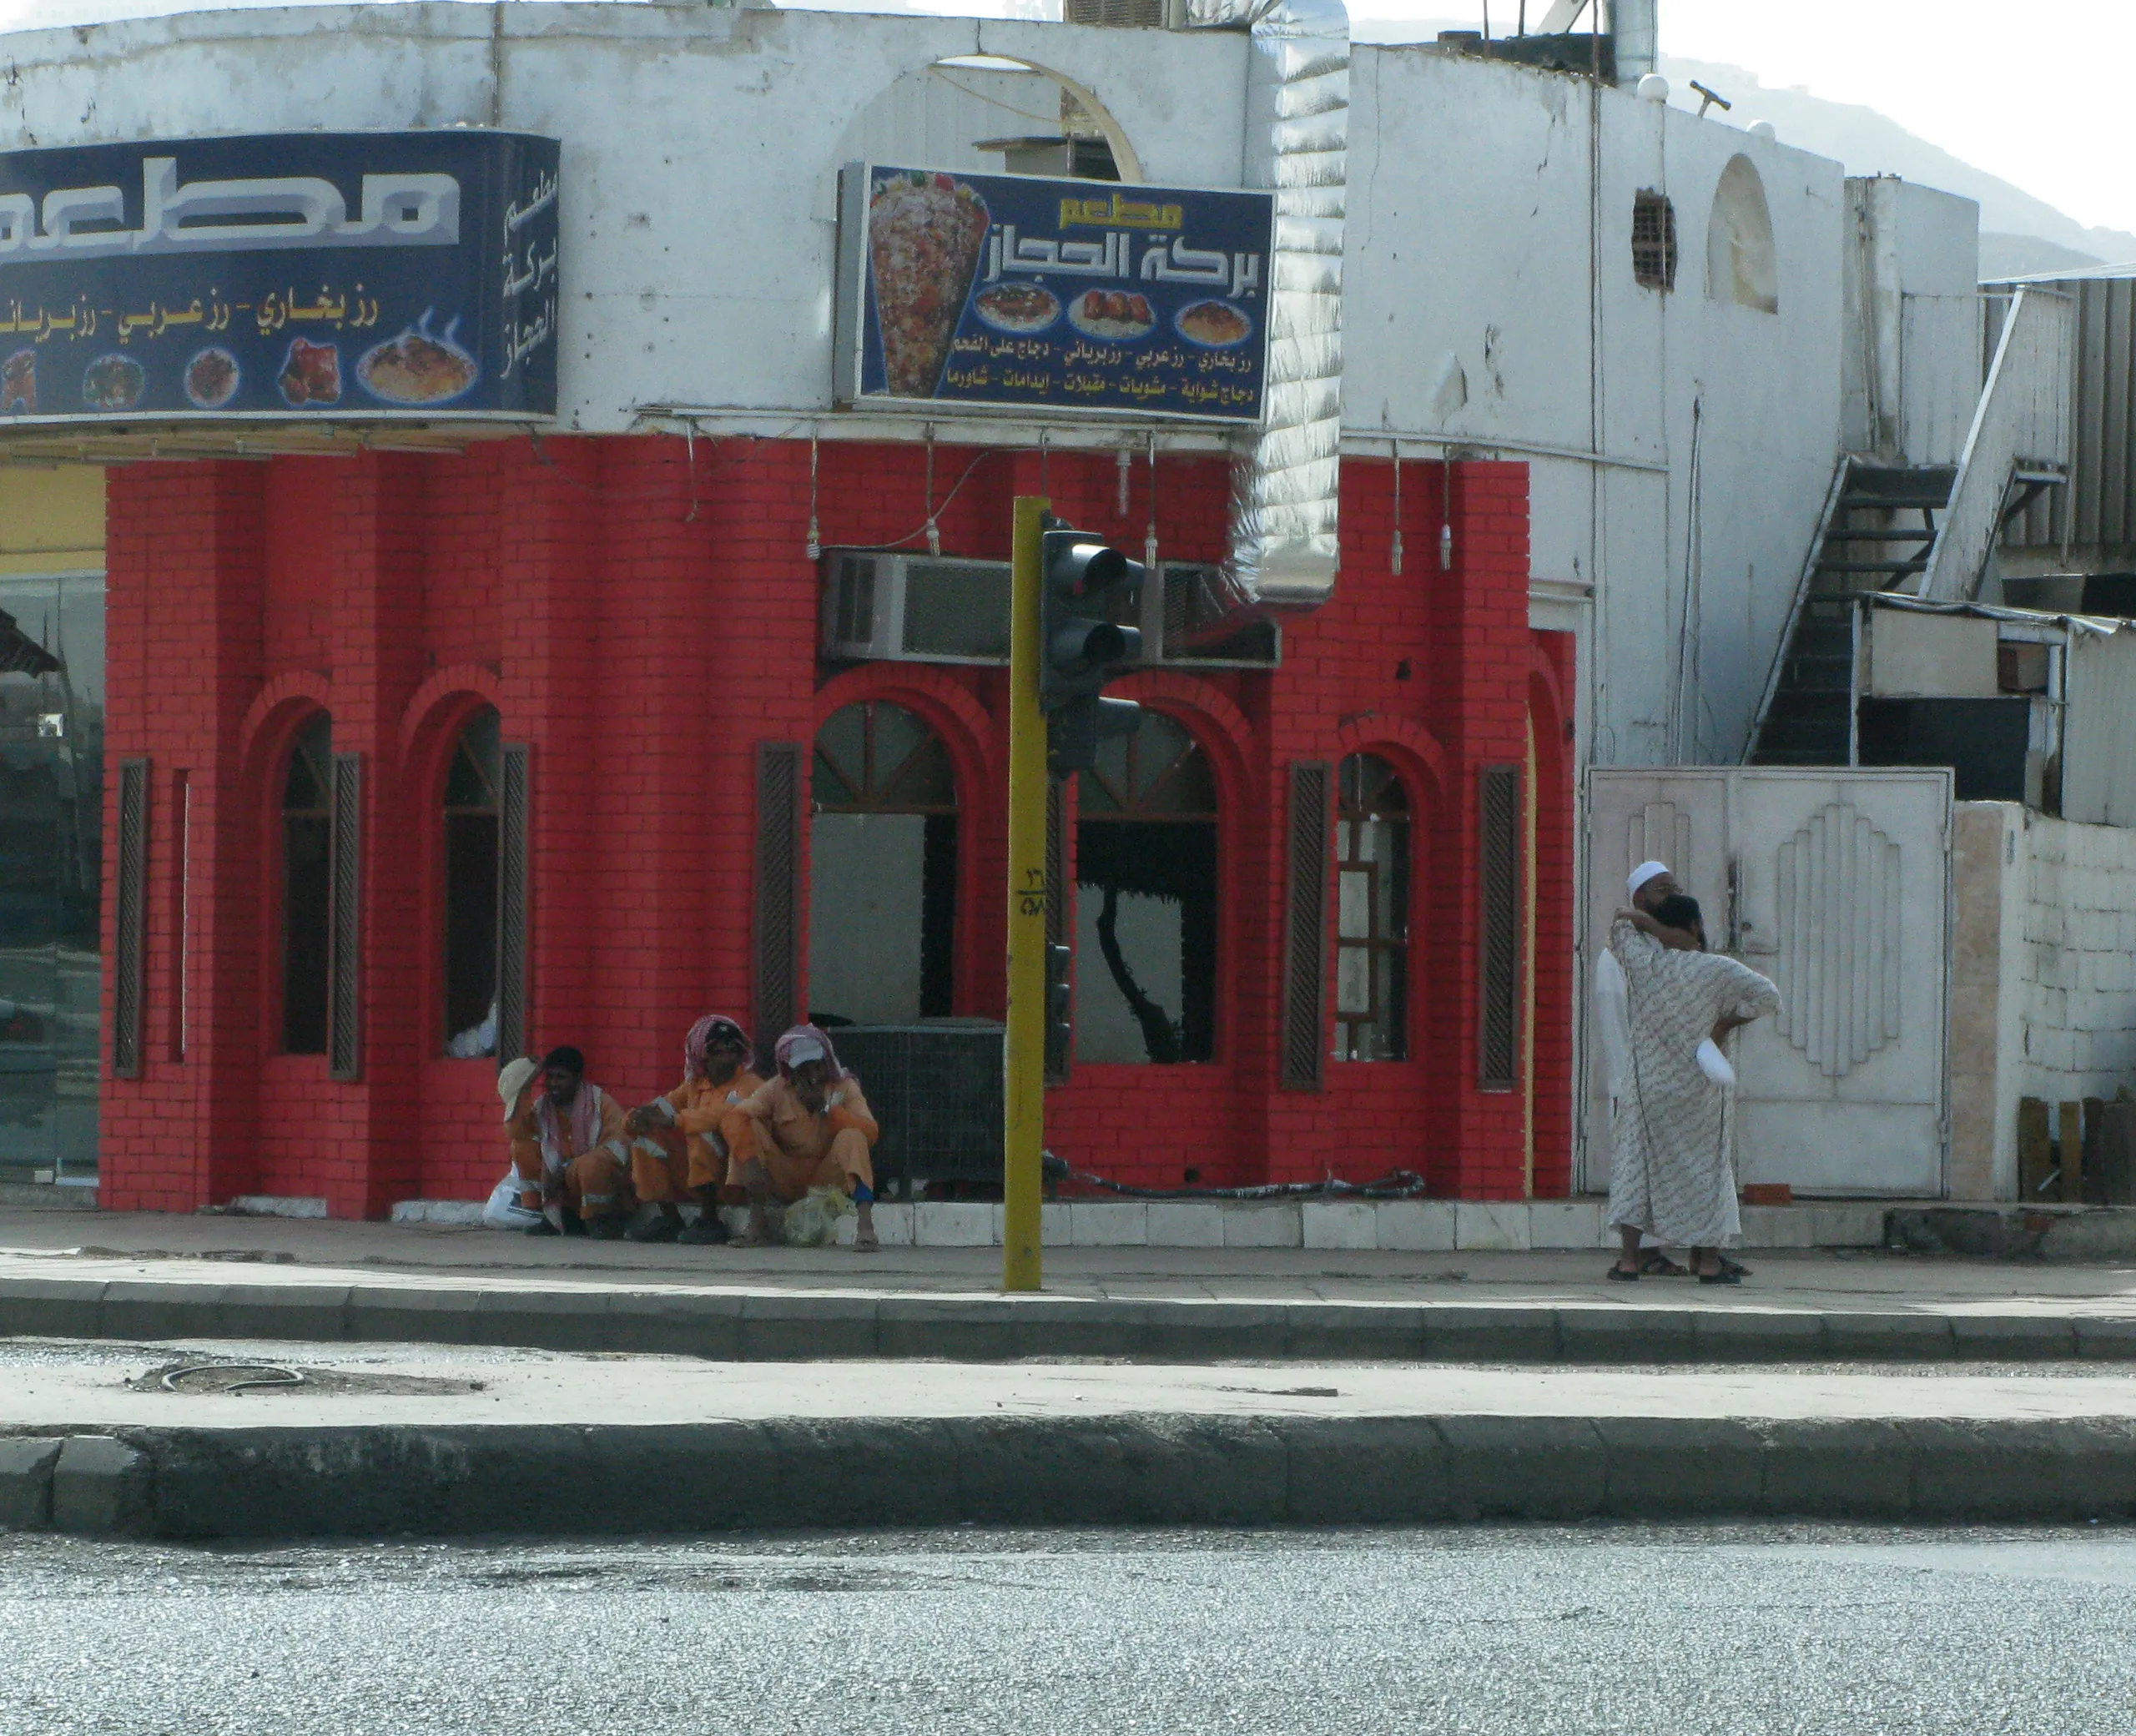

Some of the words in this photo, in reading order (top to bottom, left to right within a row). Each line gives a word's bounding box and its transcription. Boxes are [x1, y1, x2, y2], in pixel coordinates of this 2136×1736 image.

[0, 156, 461, 264] مطعم
[503, 170, 558, 248] مطعم
[1058, 193, 1182, 229] مطعم
[502, 237, 557, 298] بركة
[983, 224, 1130, 283] الحجاز
[1139, 234, 1260, 299] بركة
[0, 299, 76, 344] بريان
[77, 294, 97, 336] رز
[118, 298, 203, 345] عربي
[206, 287, 229, 331] رز
[257, 285, 345, 336] بخاري
[350, 282, 378, 328] رز
[500, 295, 556, 380] الحجاز
[1018, 339, 1050, 360] دجاج
[1108, 342, 1121, 365] رز
[1171, 345, 1185, 368] رز
[1136, 349, 1169, 371] عربي
[1198, 350, 1236, 373] بخاري
[1237, 351, 1252, 373] رز
[1220, 384, 1253, 405] دجاج
